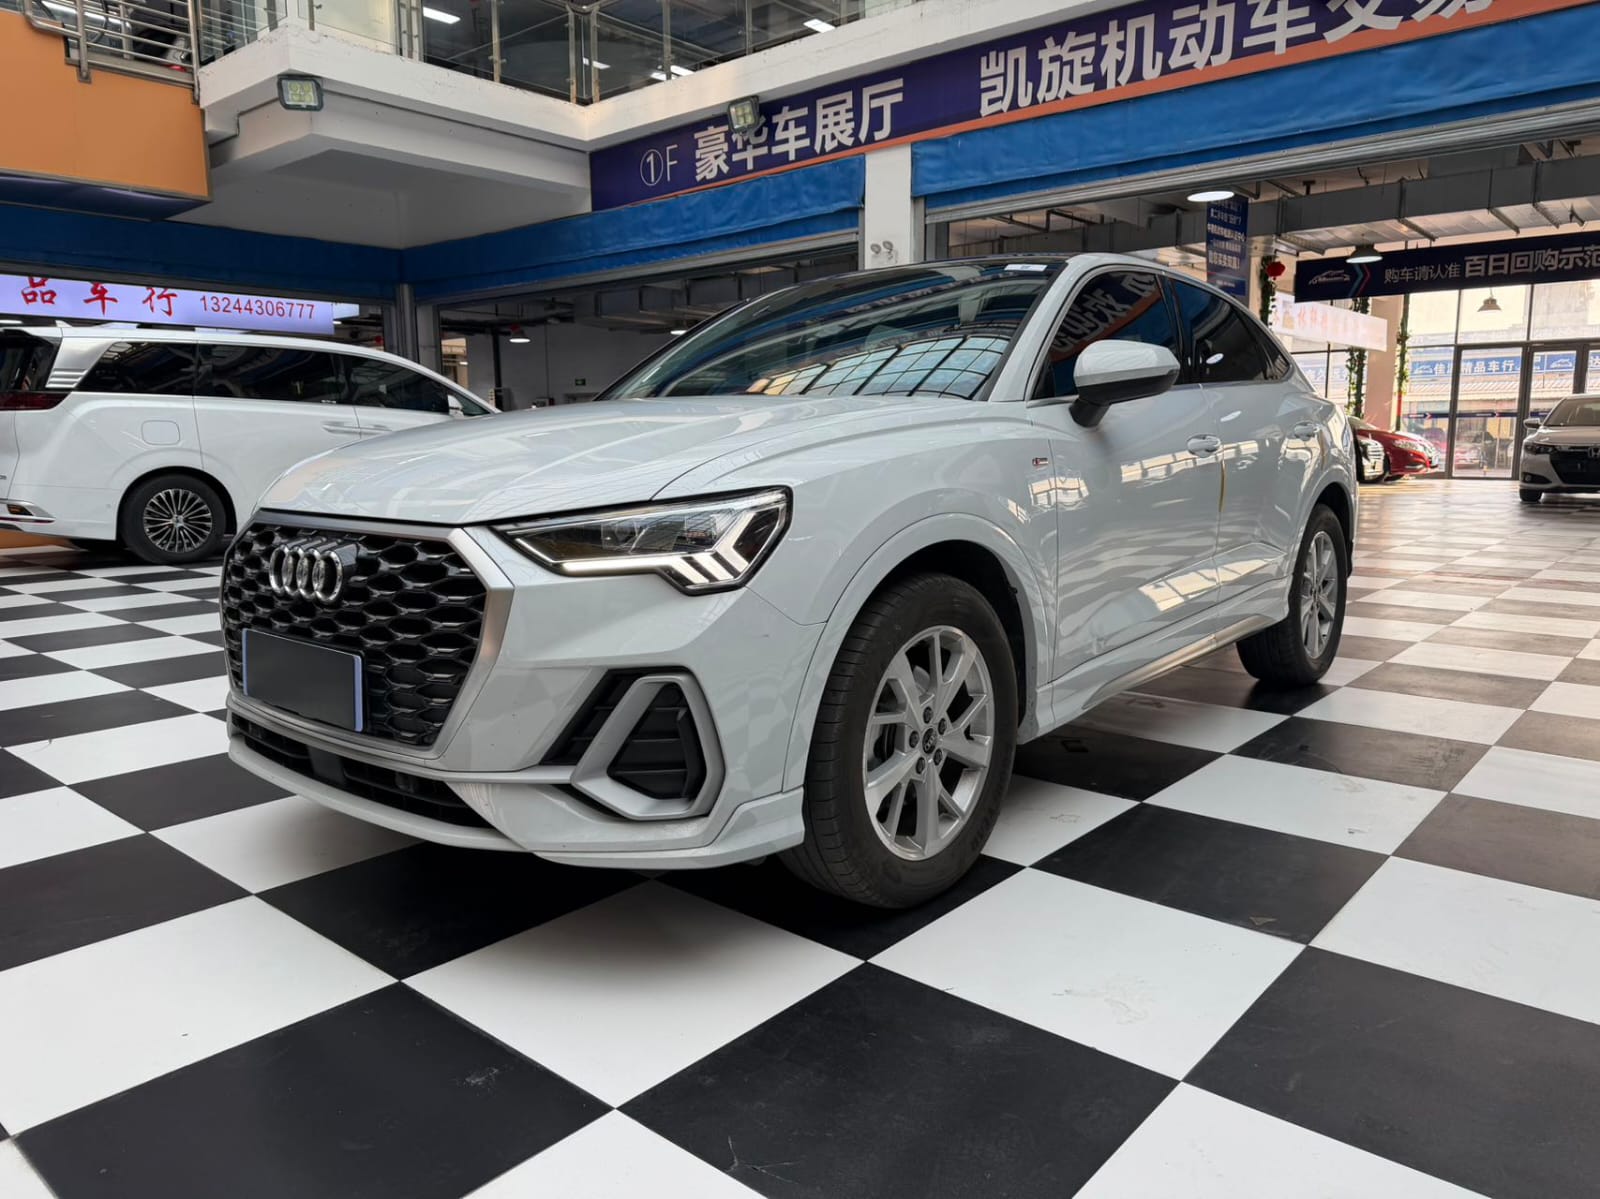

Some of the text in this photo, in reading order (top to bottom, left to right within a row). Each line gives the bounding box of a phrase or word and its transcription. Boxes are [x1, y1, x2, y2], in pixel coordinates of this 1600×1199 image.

[694, 78, 904, 182] 豪华车展厅
[980, 0, 1492, 117] 凯旋机动车交
[1384, 263, 1461, 284] 购车请认准
[200, 295, 315, 320] 13244306777
